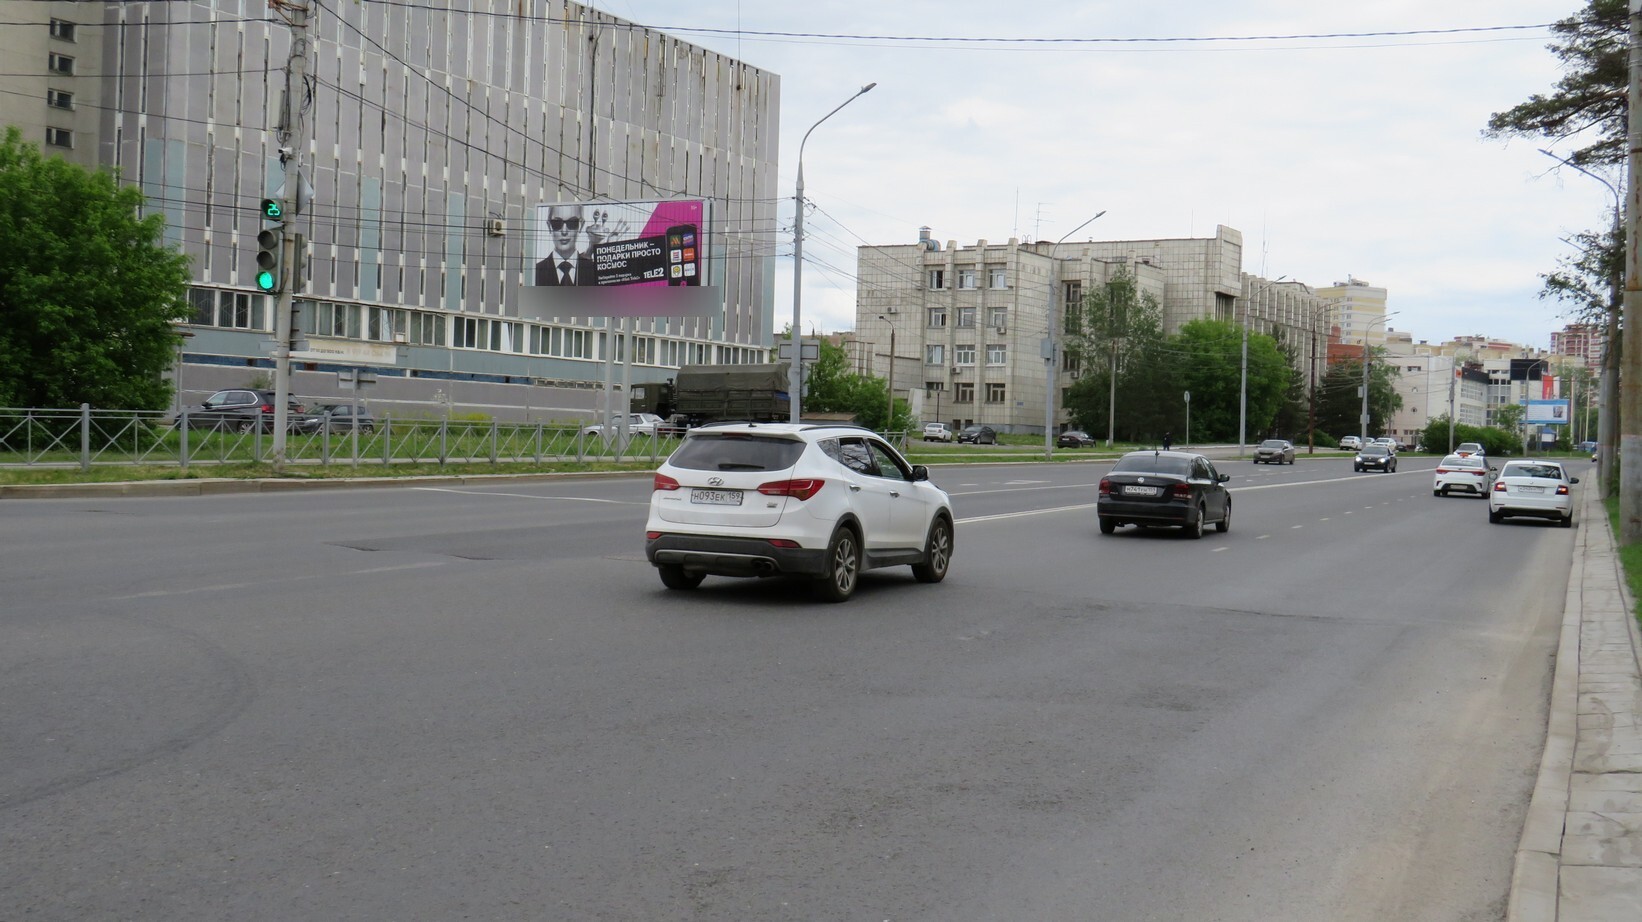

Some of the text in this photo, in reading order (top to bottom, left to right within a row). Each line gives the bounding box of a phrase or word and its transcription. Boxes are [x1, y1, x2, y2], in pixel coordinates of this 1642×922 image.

[267, 203, 280, 216] 25
[596, 241, 649, 255] ПОНЕДЕЛЬНИК
[596, 252, 631, 263] ПОДАРКИ
[631, 248, 661, 258] ПРОСТО
[597, 260, 627, 271] КОСМОС
[643, 267, 664, 279] TELE2
[693, 491, 726, 501] Н093ЕК
